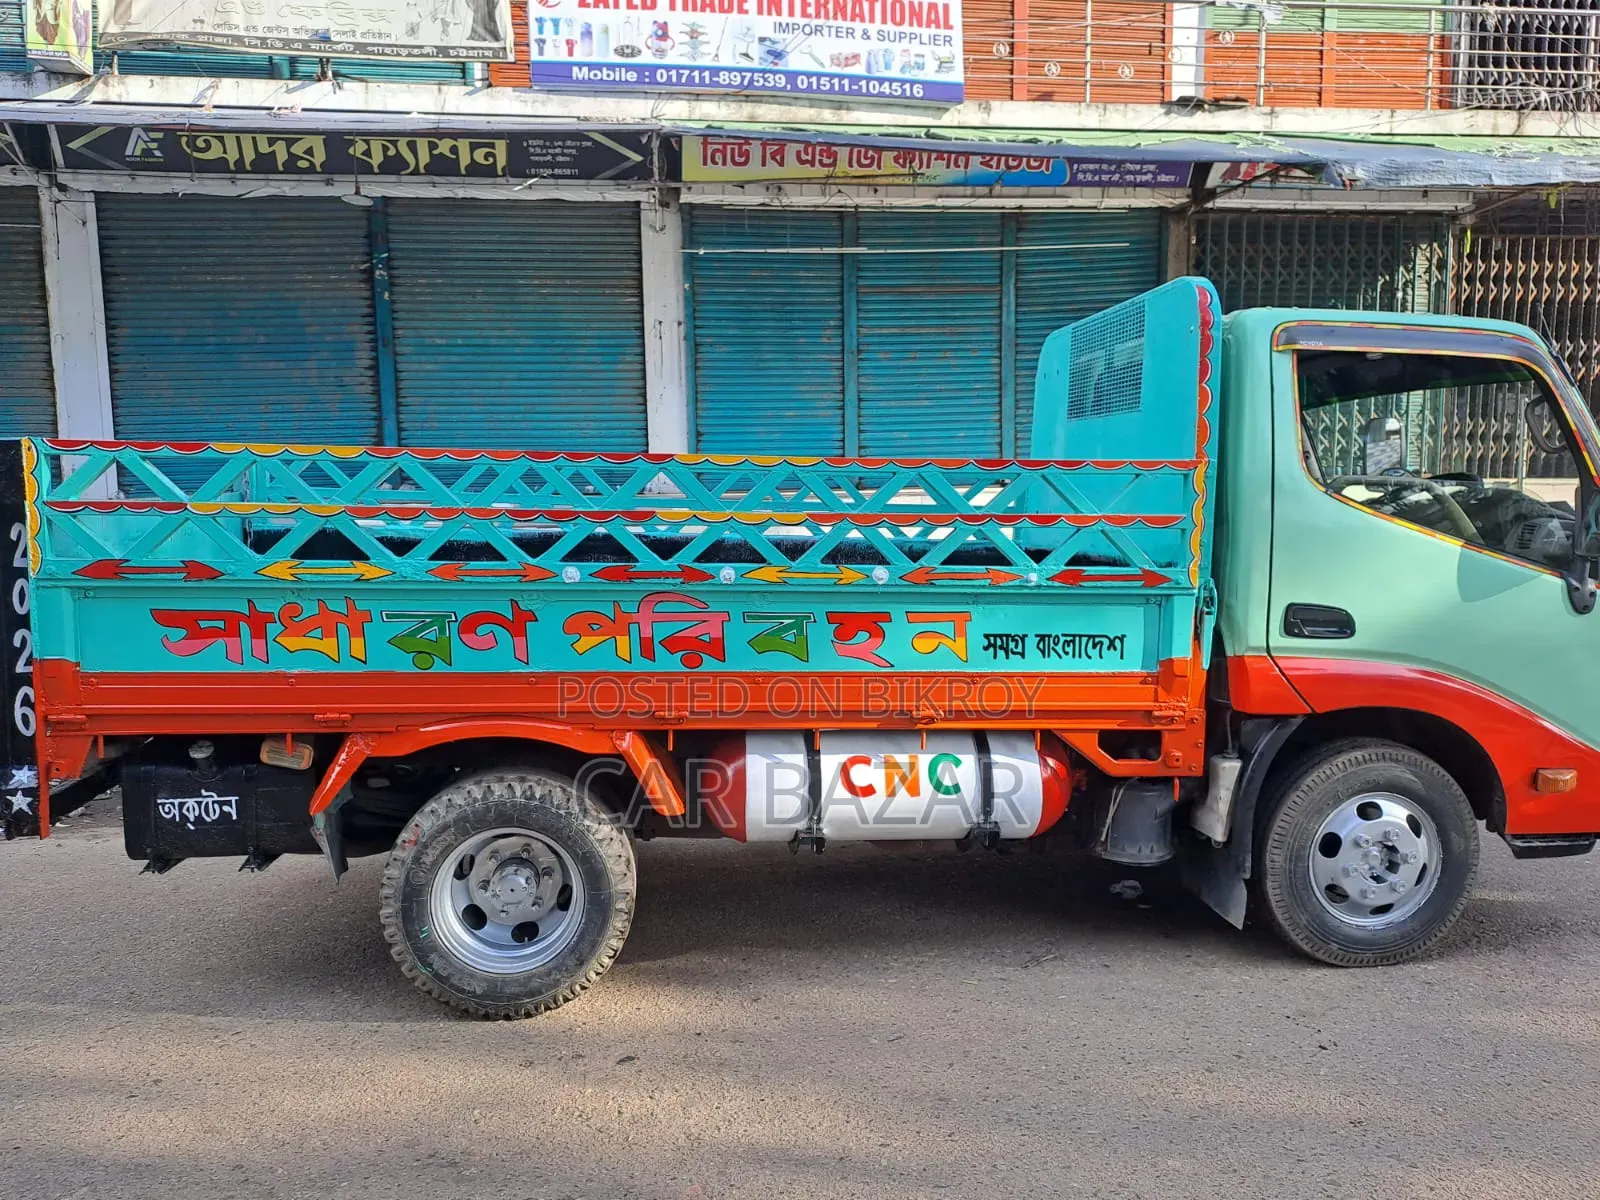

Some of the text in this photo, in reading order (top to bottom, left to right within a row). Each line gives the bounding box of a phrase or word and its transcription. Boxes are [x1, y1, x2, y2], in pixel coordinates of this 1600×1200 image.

[757, 0, 954, 30] INTERNATIONAL
[773, 21, 954, 47] IMPORTER & SUPPLIER
[571, 66, 638, 82] Mobile
[656, 69, 791, 91] 01711-897539,
[797, 75, 924, 97] 01511-104516
[176, 132, 510, 175] আদর ফ্যাশন
[701, 136, 753, 168] নিউ
[760, 140, 787, 168] বি
[150, 591, 972, 670] সাধারণ পরিবহন
[983, 633, 1127, 660] সমগ্র বাংলাদেশ
